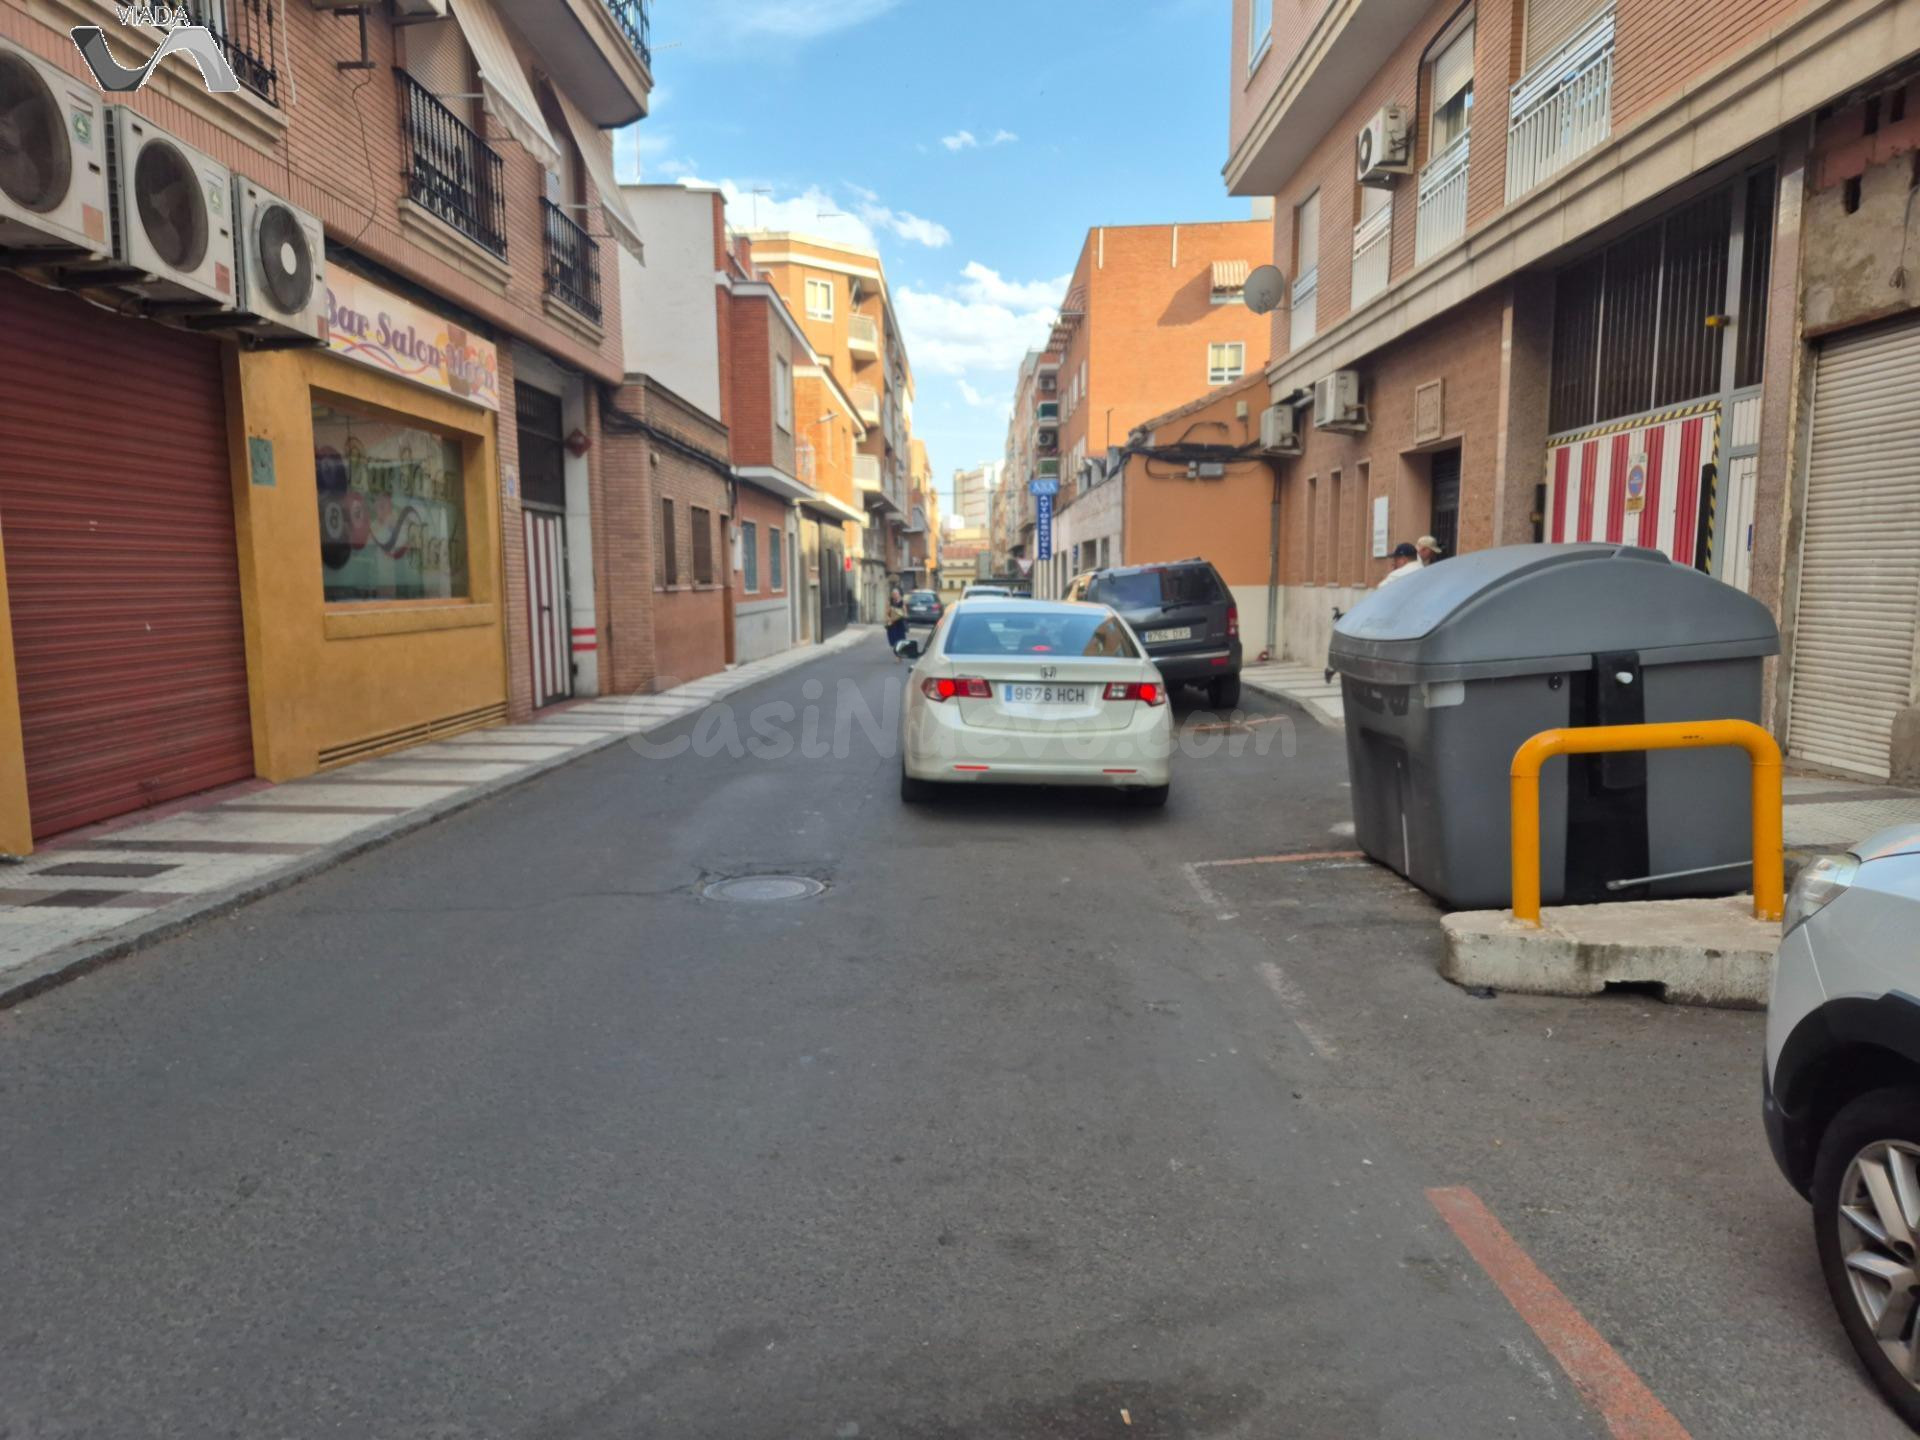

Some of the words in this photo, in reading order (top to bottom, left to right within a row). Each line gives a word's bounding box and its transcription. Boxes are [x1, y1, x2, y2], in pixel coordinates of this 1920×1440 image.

[326, 287, 369, 341] Bar
[1040, 495, 1050, 560] AUTOESCUELA
[1015, 687, 1052, 701] 9676
[1057, 688, 1085, 702] HCH
